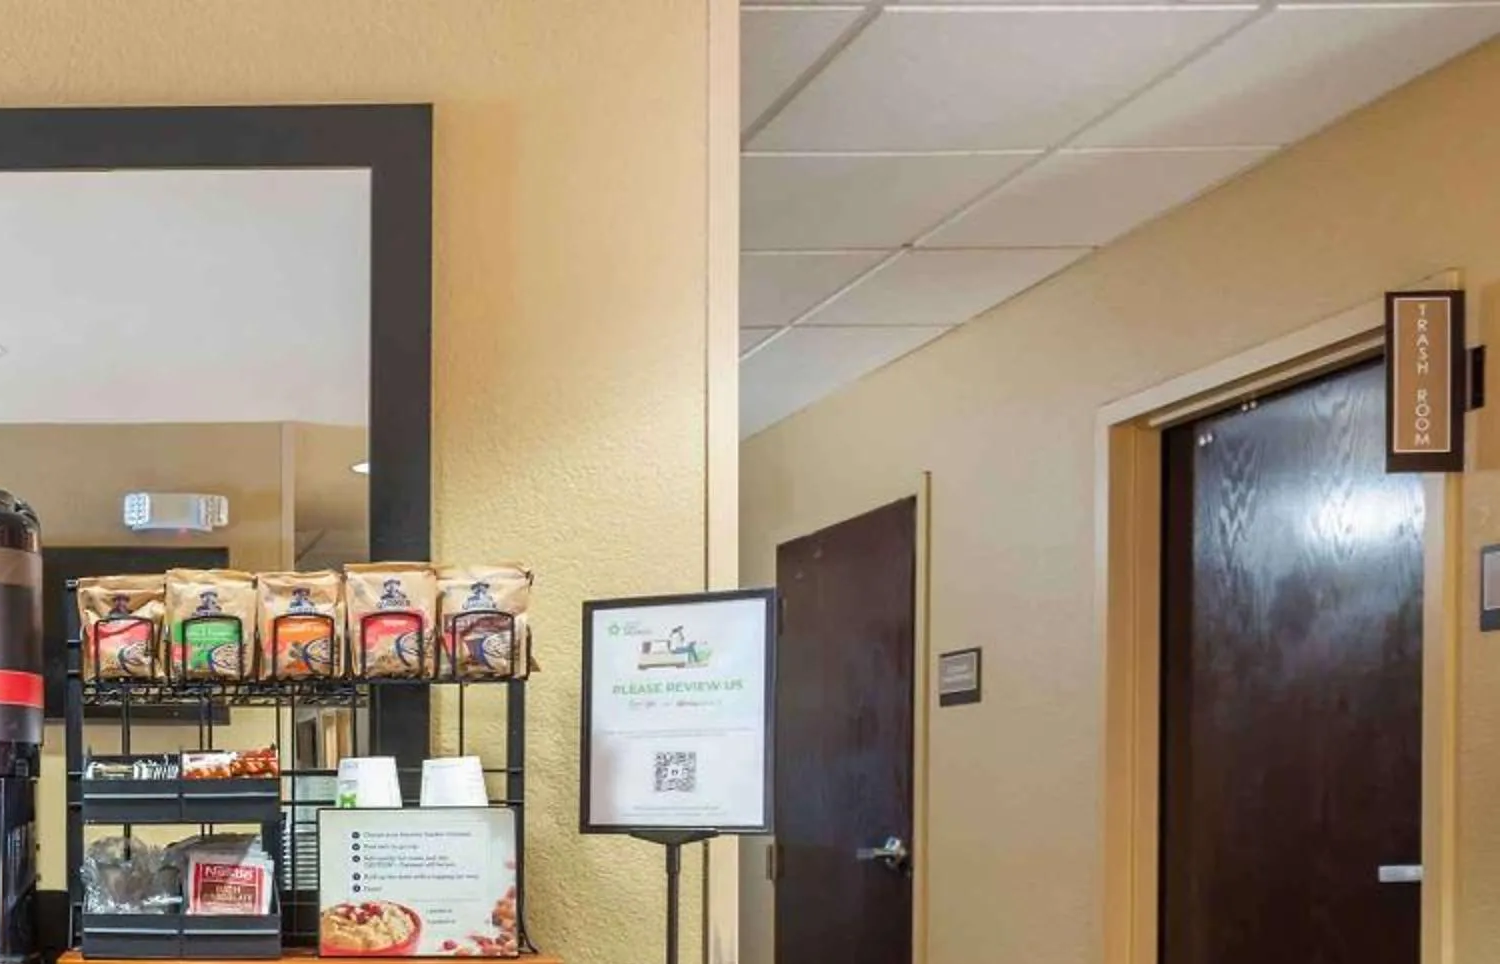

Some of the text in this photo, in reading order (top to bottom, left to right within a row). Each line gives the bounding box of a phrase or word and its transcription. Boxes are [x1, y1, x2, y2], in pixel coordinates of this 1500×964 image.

[1414, 303, 1431, 446] TRASH ROOM
[612, 677, 744, 696] PLEASE REVIEW US
